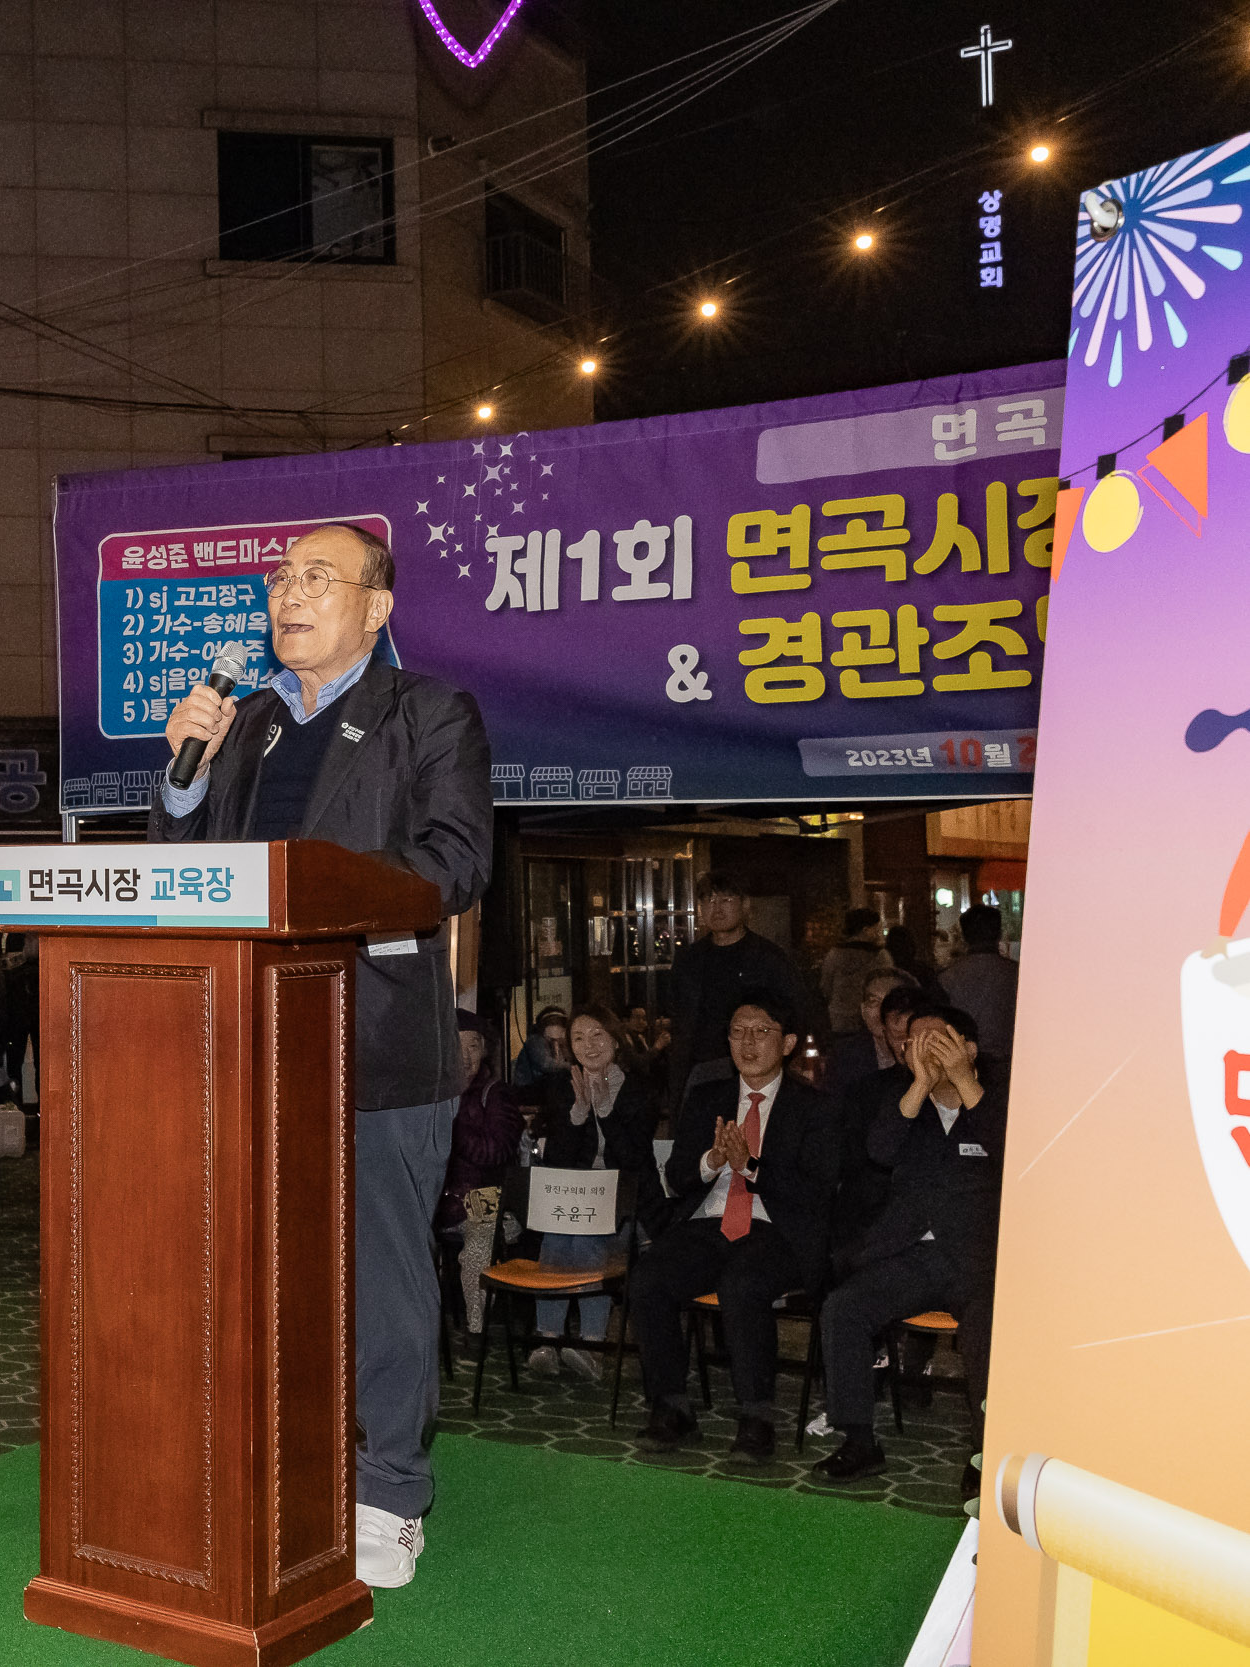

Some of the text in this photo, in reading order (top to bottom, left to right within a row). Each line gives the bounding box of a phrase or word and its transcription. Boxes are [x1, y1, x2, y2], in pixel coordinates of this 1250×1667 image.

[977, 188, 1004, 288] 상명교회
[121, 543, 190, 570] 윤성준
[485, 515, 694, 613] 제1회
[125, 584, 256, 613] 1) sj 고고장구
[122, 611, 268, 636] 2) 가수-송혜옥
[122, 639, 265, 665] 3) 가수-여주
[666, 596, 1049, 705] & 경관조
[122, 670, 145, 694] 4)
[845, 746, 935, 767] 2023년
[938, 737, 1013, 769] 10월
[28, 866, 235, 903] 면곡시장 교육장
[544, 1183, 607, 1197] 광진구의회 의장
[551, 1204, 598, 1223] 추윤구
